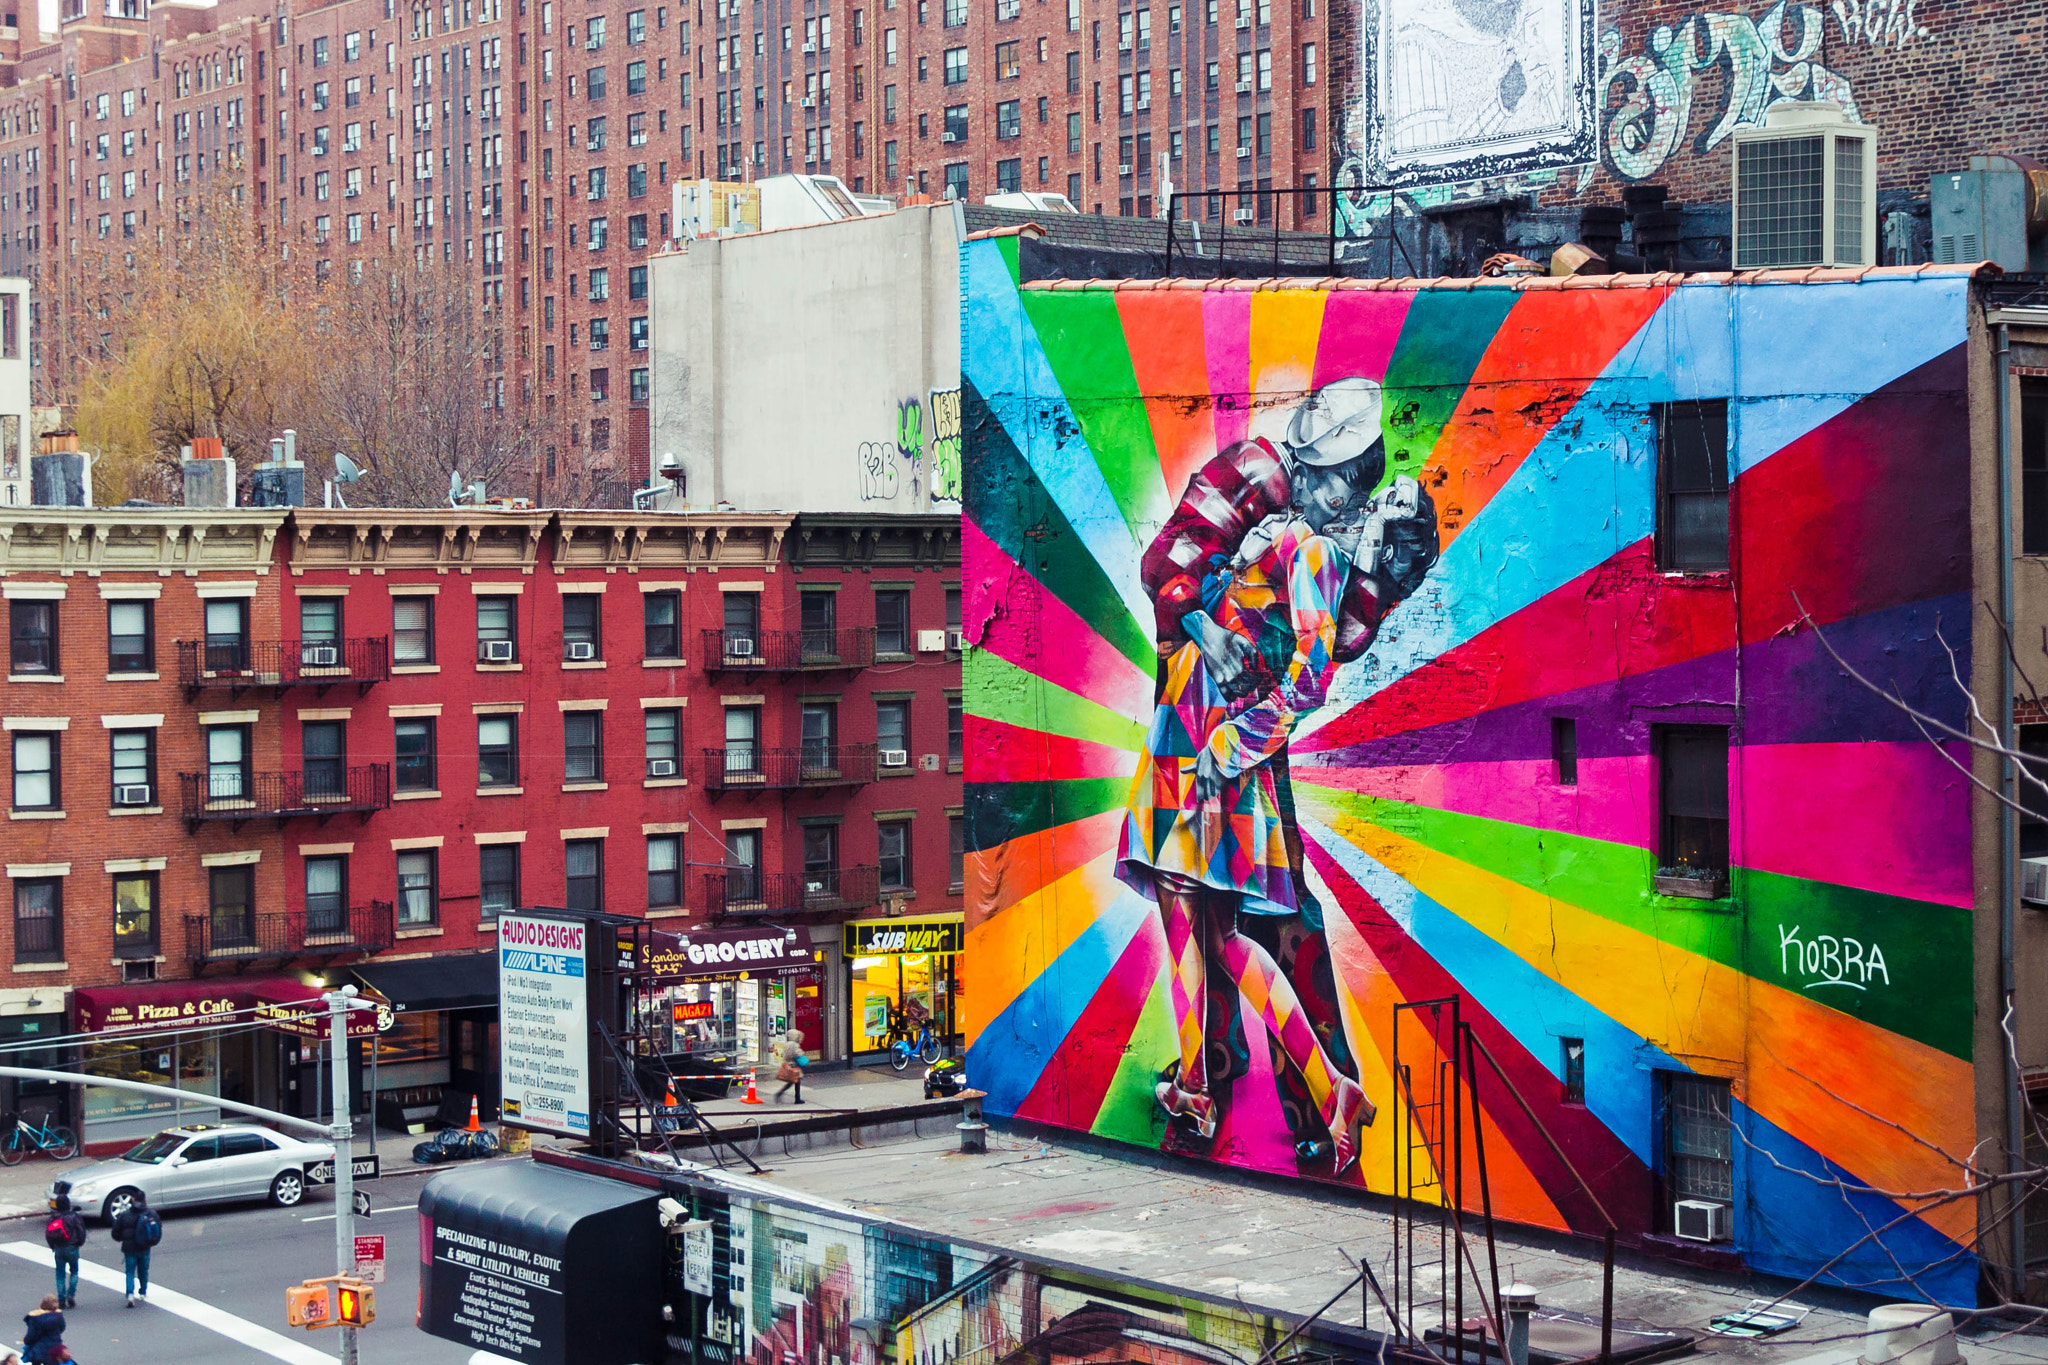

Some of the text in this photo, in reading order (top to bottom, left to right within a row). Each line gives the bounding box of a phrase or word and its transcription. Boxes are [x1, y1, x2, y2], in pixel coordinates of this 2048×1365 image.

[858, 441, 899, 501] R2B
[502, 920, 583, 950] AUDIO DESIGNS
[866, 930, 950, 950] SUBWAY
[642, 938, 808, 964] London GROCERY CORP.
[1778, 923, 1890, 986] KOBRA
[522, 951, 567, 975] ALPINE
[639, 986, 665, 996] AM
[111, 1007, 128, 1015] 10th
[138, 999, 235, 1020] Pizza & Cafe
[538, 995, 549, 1011] Body
[550, 996, 562, 1009] Paint
[562, 998, 573, 1011] Work
[674, 1002, 713, 1020] MAGAZI
[106, 1014, 134, 1022] Avenue
[356, 1025, 375, 1034] Cafe
[550, 1029, 567, 1042] Devices
[161, 1055, 168, 1064] A
[531, 1042, 546, 1056] Sound
[546, 1045, 565, 1060] Systems
[544, 1061, 560, 1075] Custom
[315, 1167, 335, 1179] ONE
[436, 1226, 562, 1271] SPECIALIZING IN LUXURY, EXOTIC
[447, 1247, 550, 1287] & SPORT UTILITY VEHICLES
[469, 1272, 526, 1296] Exotic Skin Interiors
[465, 1282, 530, 1309] Exterior Enhancements
[461, 1292, 535, 1323] Audiophile Sound Systems
[463, 1304, 532, 1333] Mobile Theater Systems
[454, 1312, 542, 1348] Convenience & Safety Systems
[471, 1330, 523, 1354] High Tech Devices
